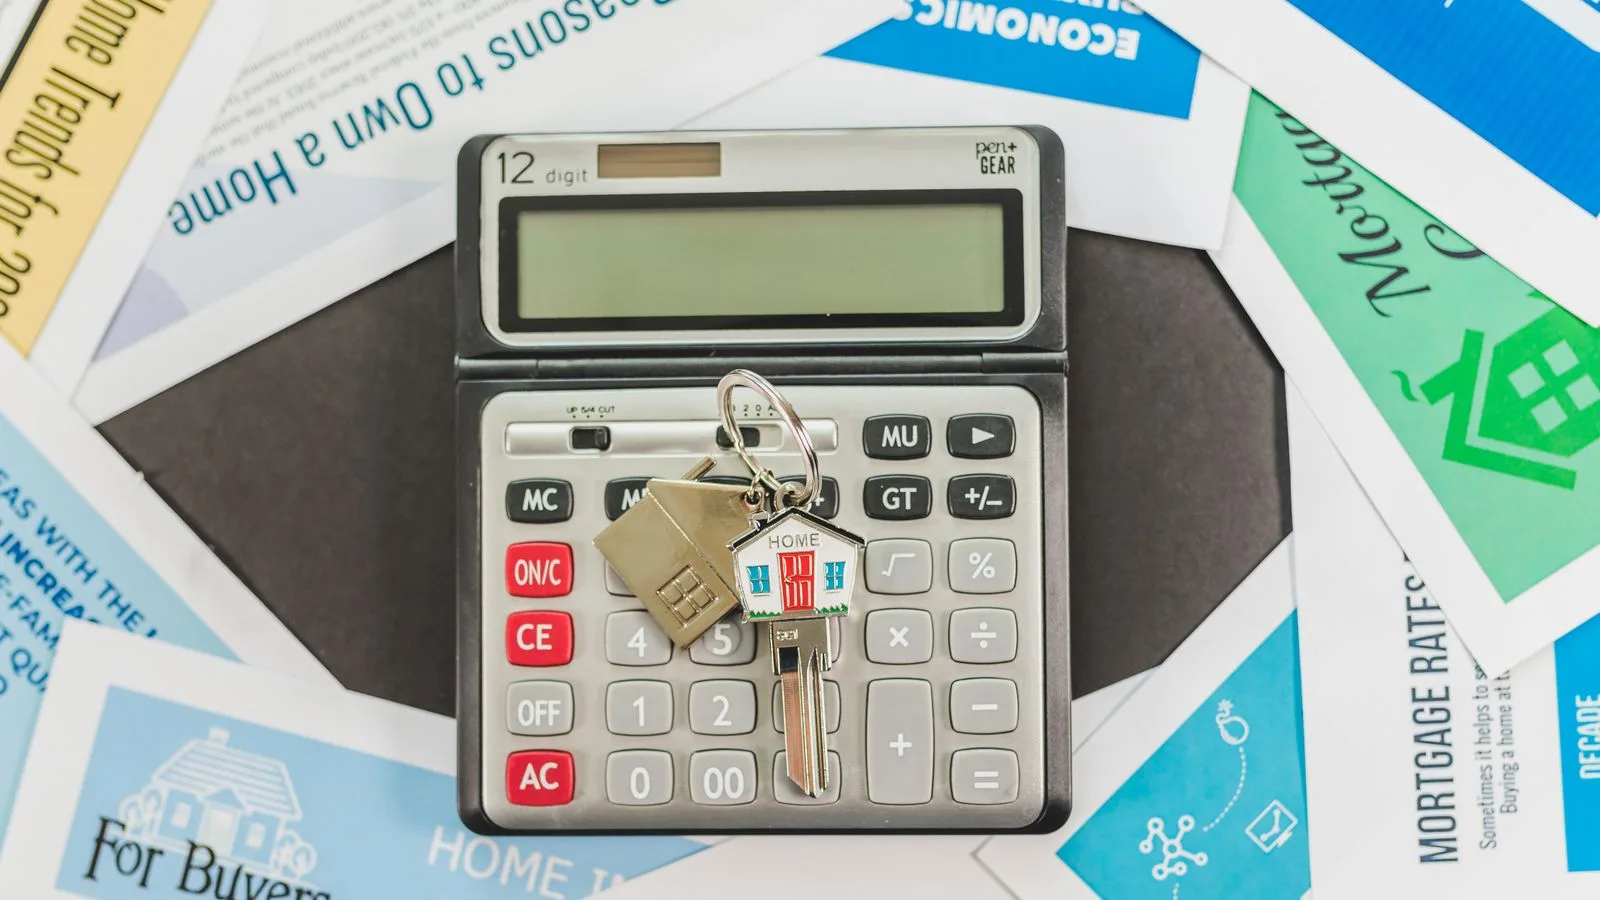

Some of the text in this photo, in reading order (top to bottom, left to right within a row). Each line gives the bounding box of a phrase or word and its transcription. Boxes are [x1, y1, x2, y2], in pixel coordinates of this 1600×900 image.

[488, 0, 672, 71] asons
[437, 54, 494, 96] to
[6, 66, 121, 180] Trends
[333, 82, 435, 150] Own
[294, 132, 326, 168] a
[980, 156, 1016, 175] GEAR
[497, 151, 588, 187] 12 digit
[167, 149, 297, 235] Home
[881, 425, 919, 448] MU
[522, 488, 558, 511] MC
[882, 487, 918, 511] GT
[768, 533, 821, 550] HOME
[0, 533, 100, 624] INCREA
[36, 517, 98, 584] WITH
[98, 580, 145, 632] THE
[514, 559, 562, 587] ON/C
[516, 624, 553, 651] CE
[627, 631, 647, 657] 4
[713, 624, 733, 656] 5
[10, 648, 47, 692] QU
[1472, 685, 1489, 700] to
[1494, 686, 1512, 701] at
[517, 700, 562, 726] OFF
[632, 696, 645, 727] 1
[712, 695, 733, 727] 2
[1473, 704, 1493, 747] helps
[1498, 707, 1513, 747] home
[1474, 749, 1491, 764] it
[1502, 750, 1515, 760] a
[519, 762, 560, 790] AC
[630, 767, 650, 800] 0
[703, 767, 745, 800] 00
[1411, 686, 1458, 863] MORTGAGE
[1500, 762, 1519, 814] Buying
[1476, 765, 1497, 850] Sometimes
[84, 817, 165, 889] For
[428, 824, 574, 900] HOME
